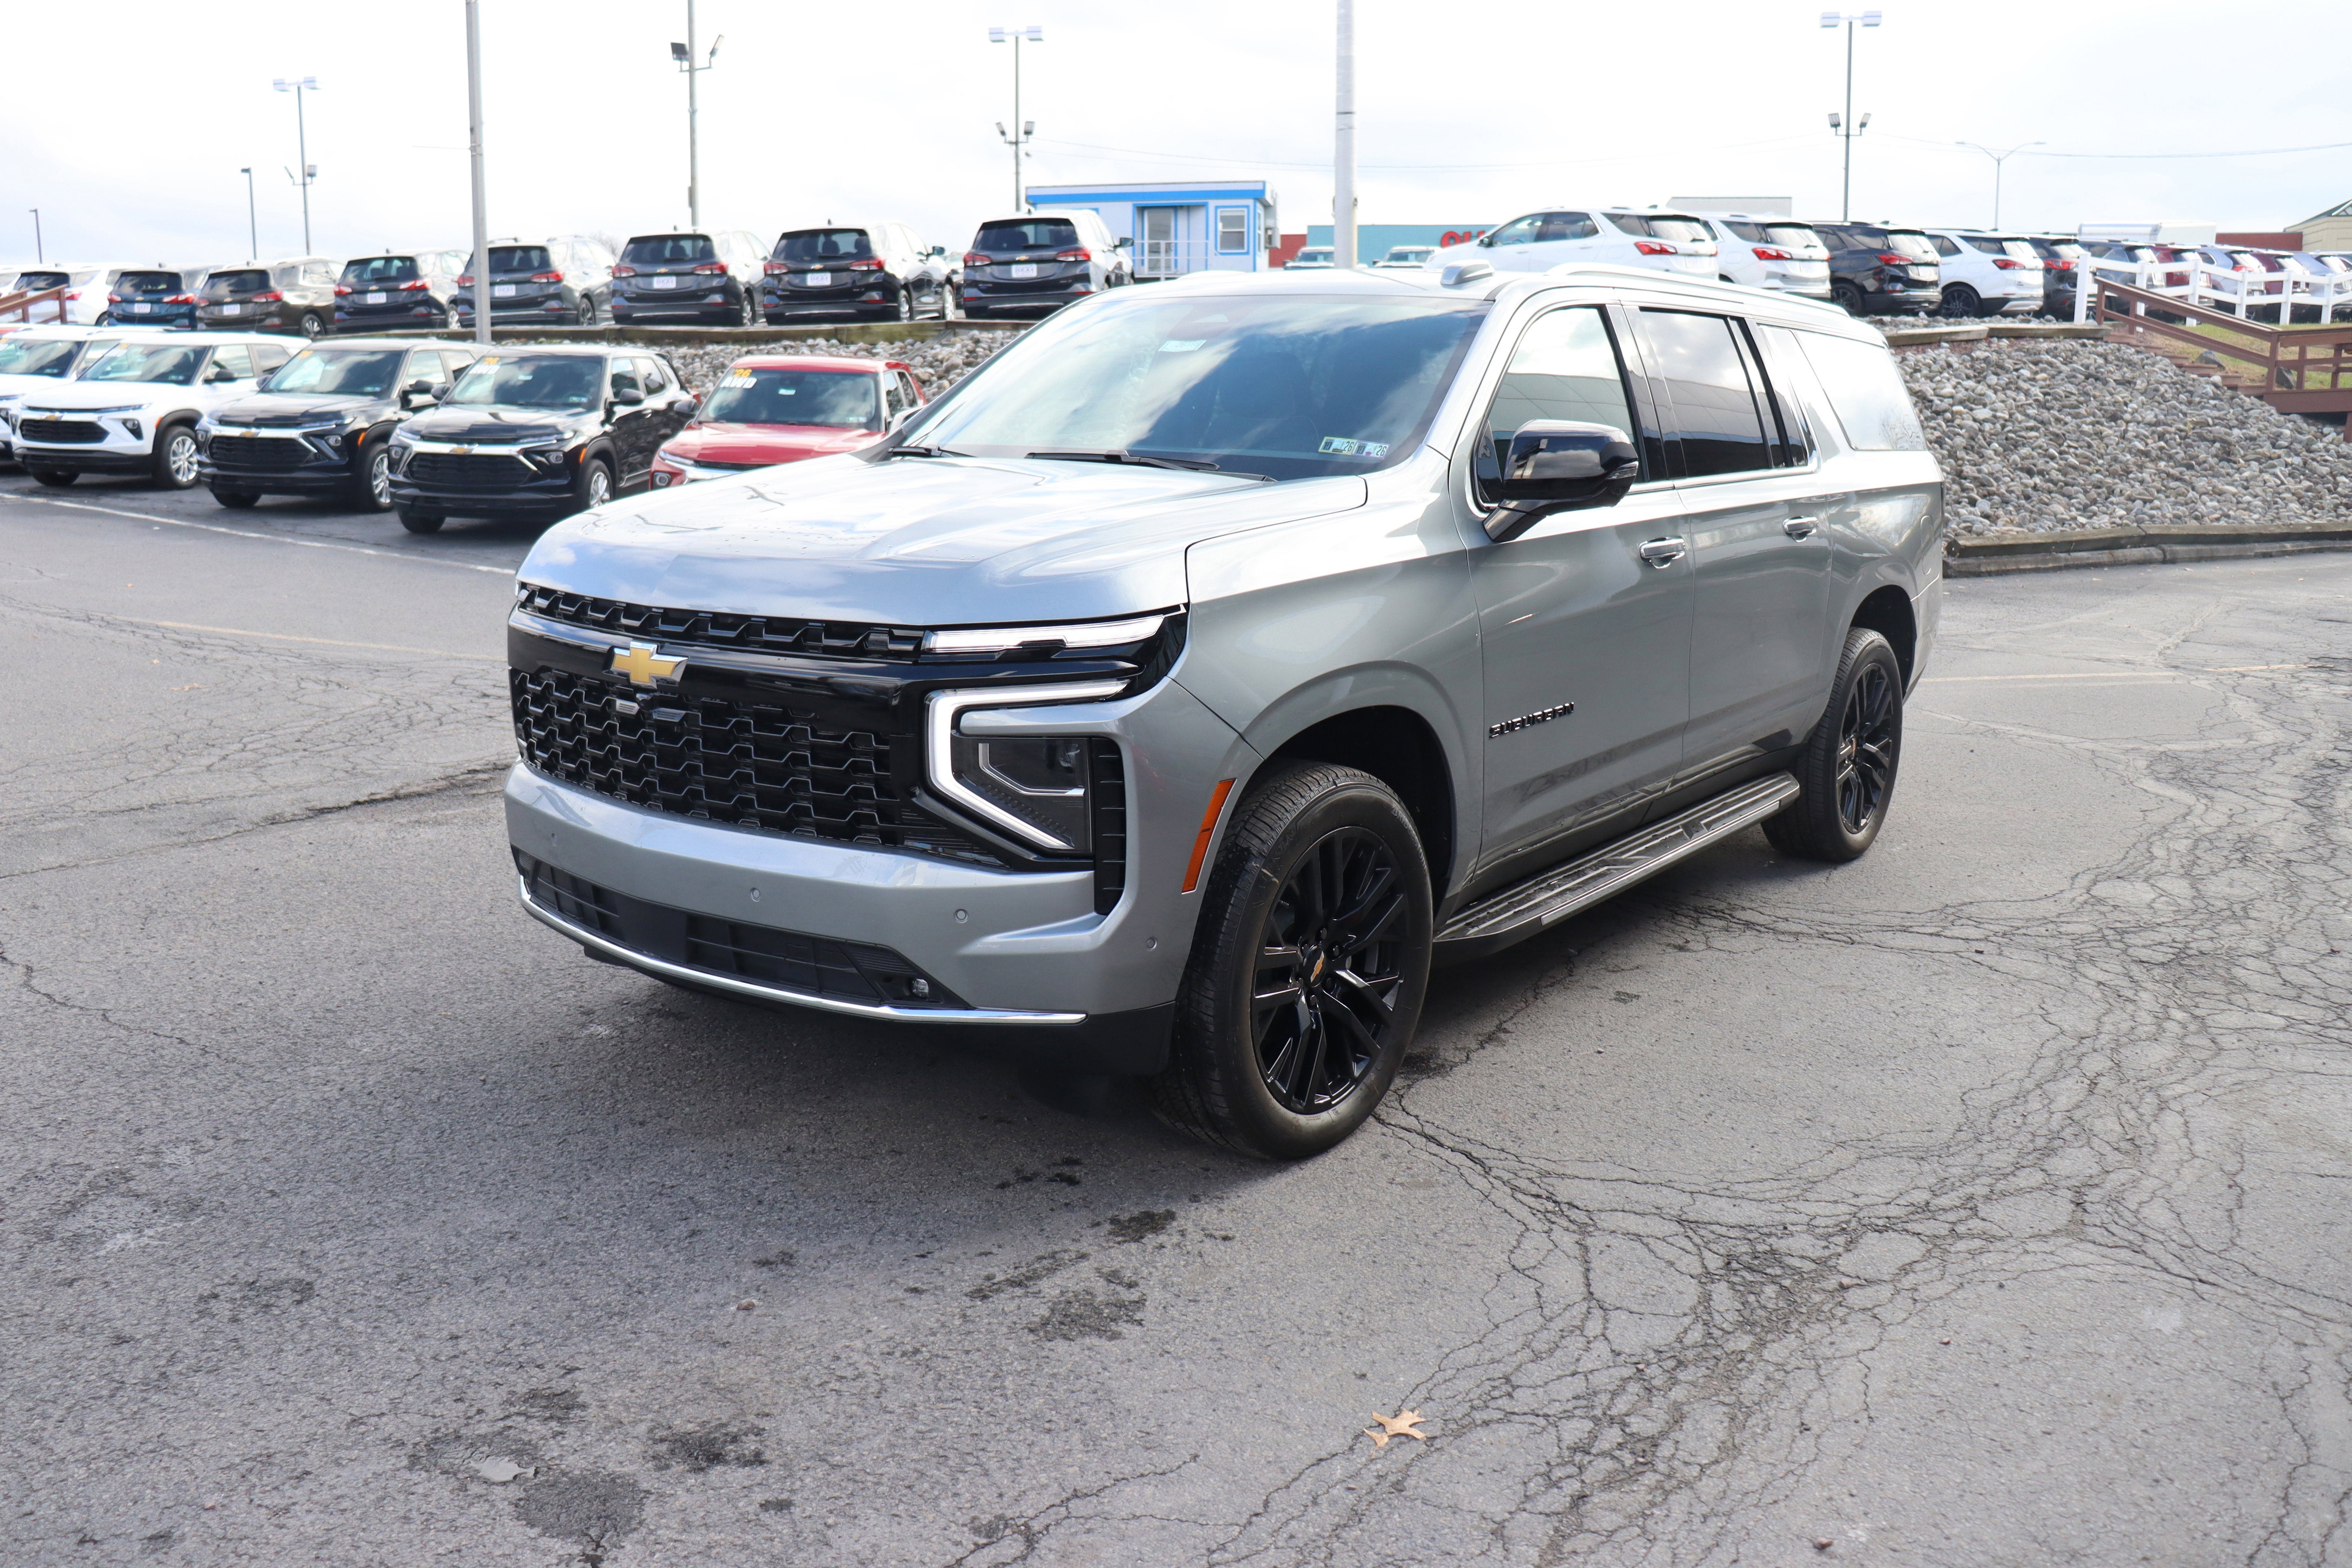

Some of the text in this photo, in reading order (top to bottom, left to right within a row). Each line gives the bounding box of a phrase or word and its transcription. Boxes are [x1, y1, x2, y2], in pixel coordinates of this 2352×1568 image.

[720, 377, 757, 389] AWD
[1344, 441, 1354, 451] 26
[1376, 445, 1387, 456] 26
[1489, 702, 1575, 738] SUBURBAN
